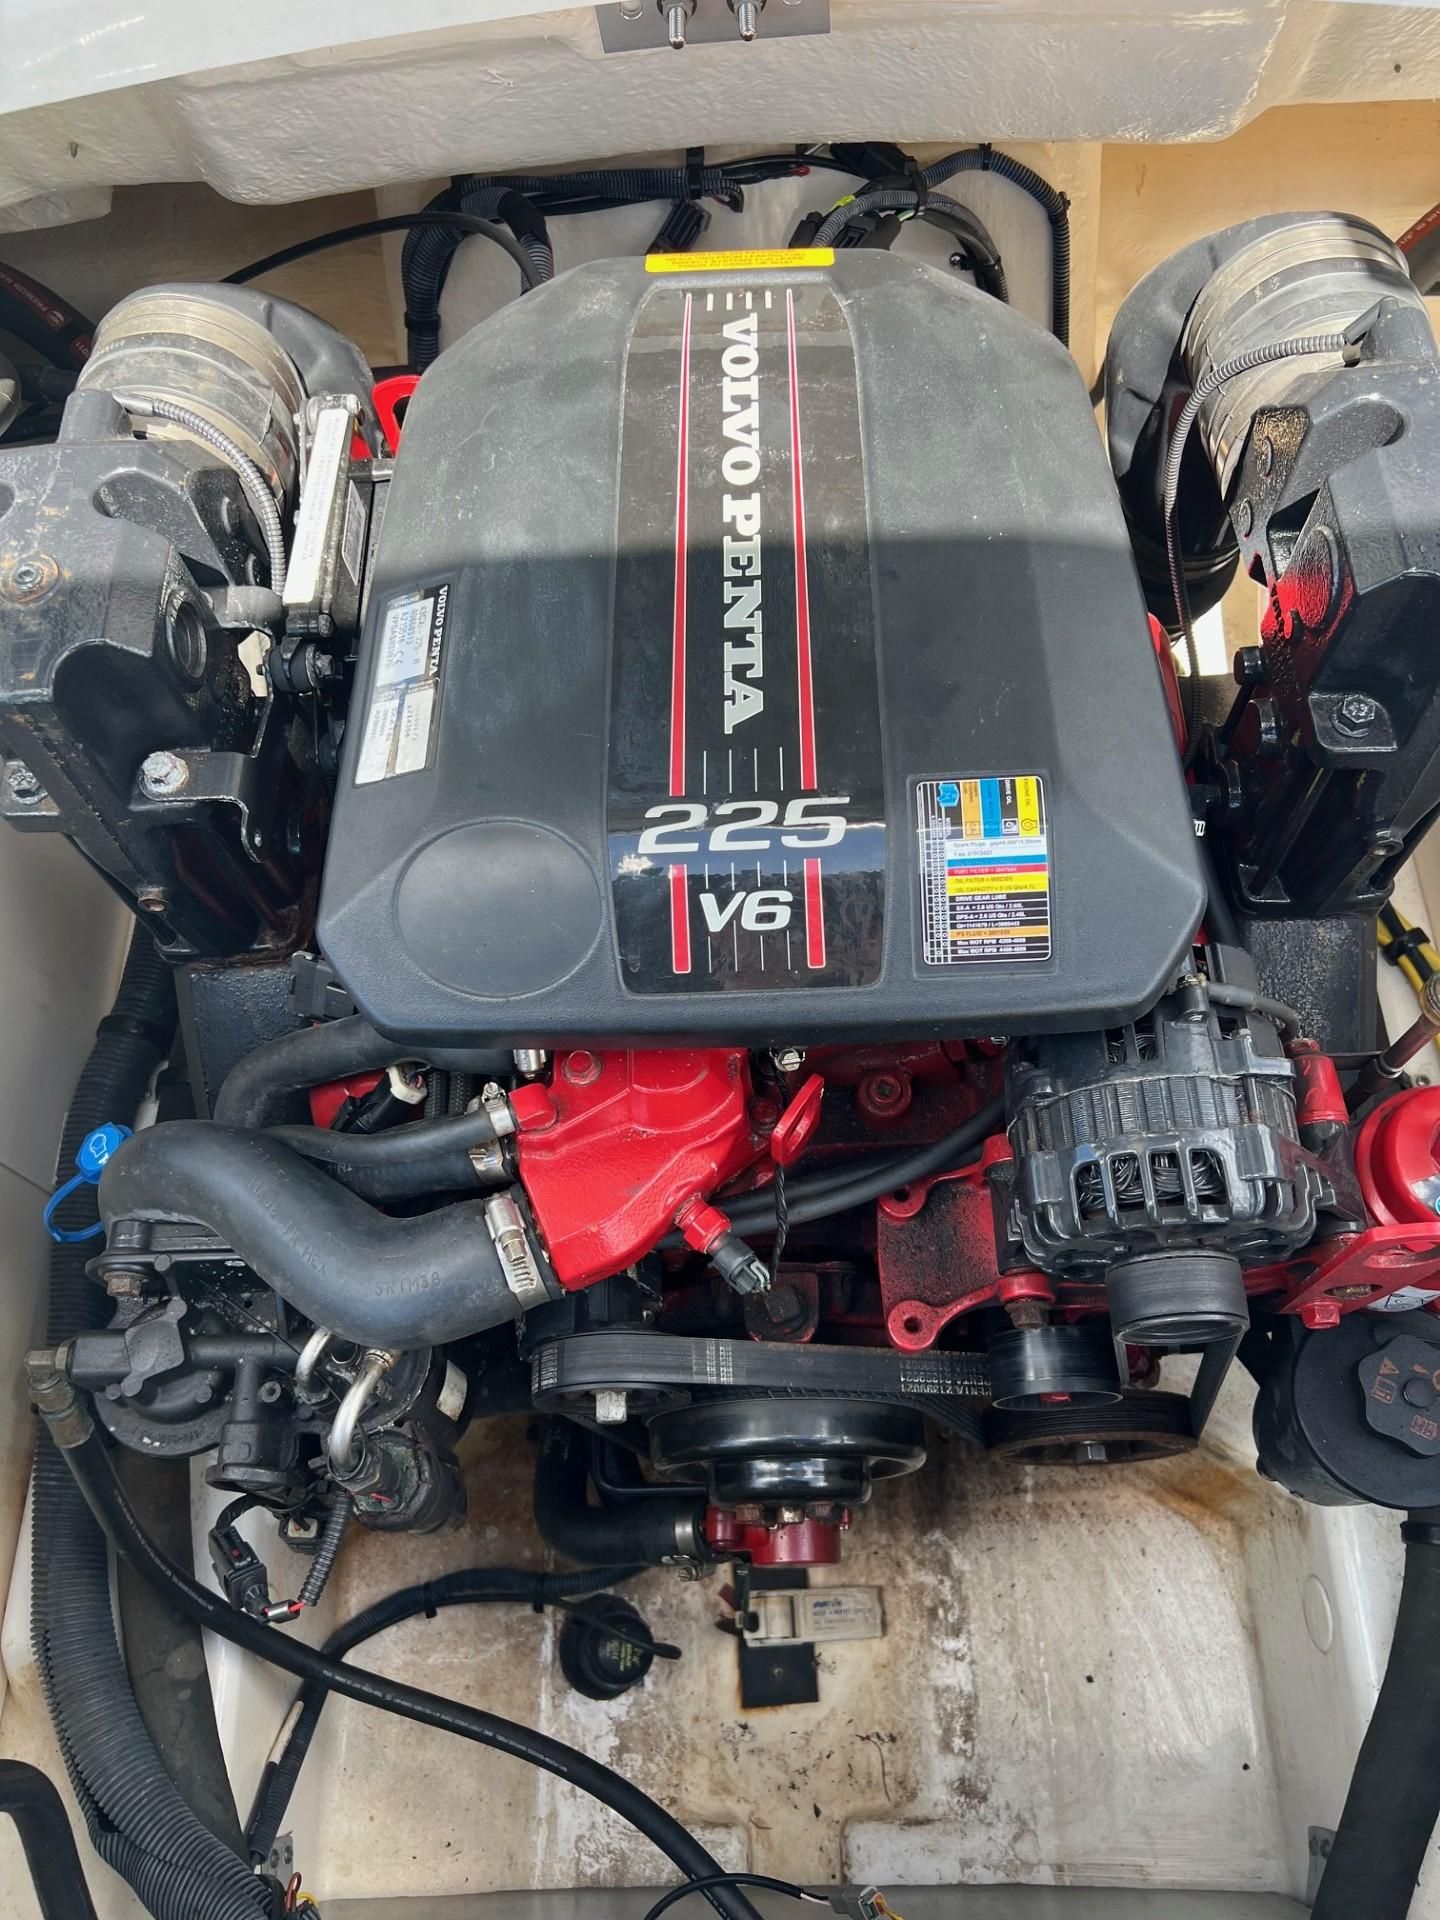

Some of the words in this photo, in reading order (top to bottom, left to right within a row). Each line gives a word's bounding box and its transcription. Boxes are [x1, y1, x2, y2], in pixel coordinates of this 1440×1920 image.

[721, 313, 760, 486] VOLVO
[436, 585, 448, 626] VOLVO
[722, 494, 764, 735] PENTA
[429, 627, 442, 676] PENTA
[638, 797, 850, 854] 225
[700, 890, 792, 933] V6
[955, 1386, 991, 1396] PENTA
